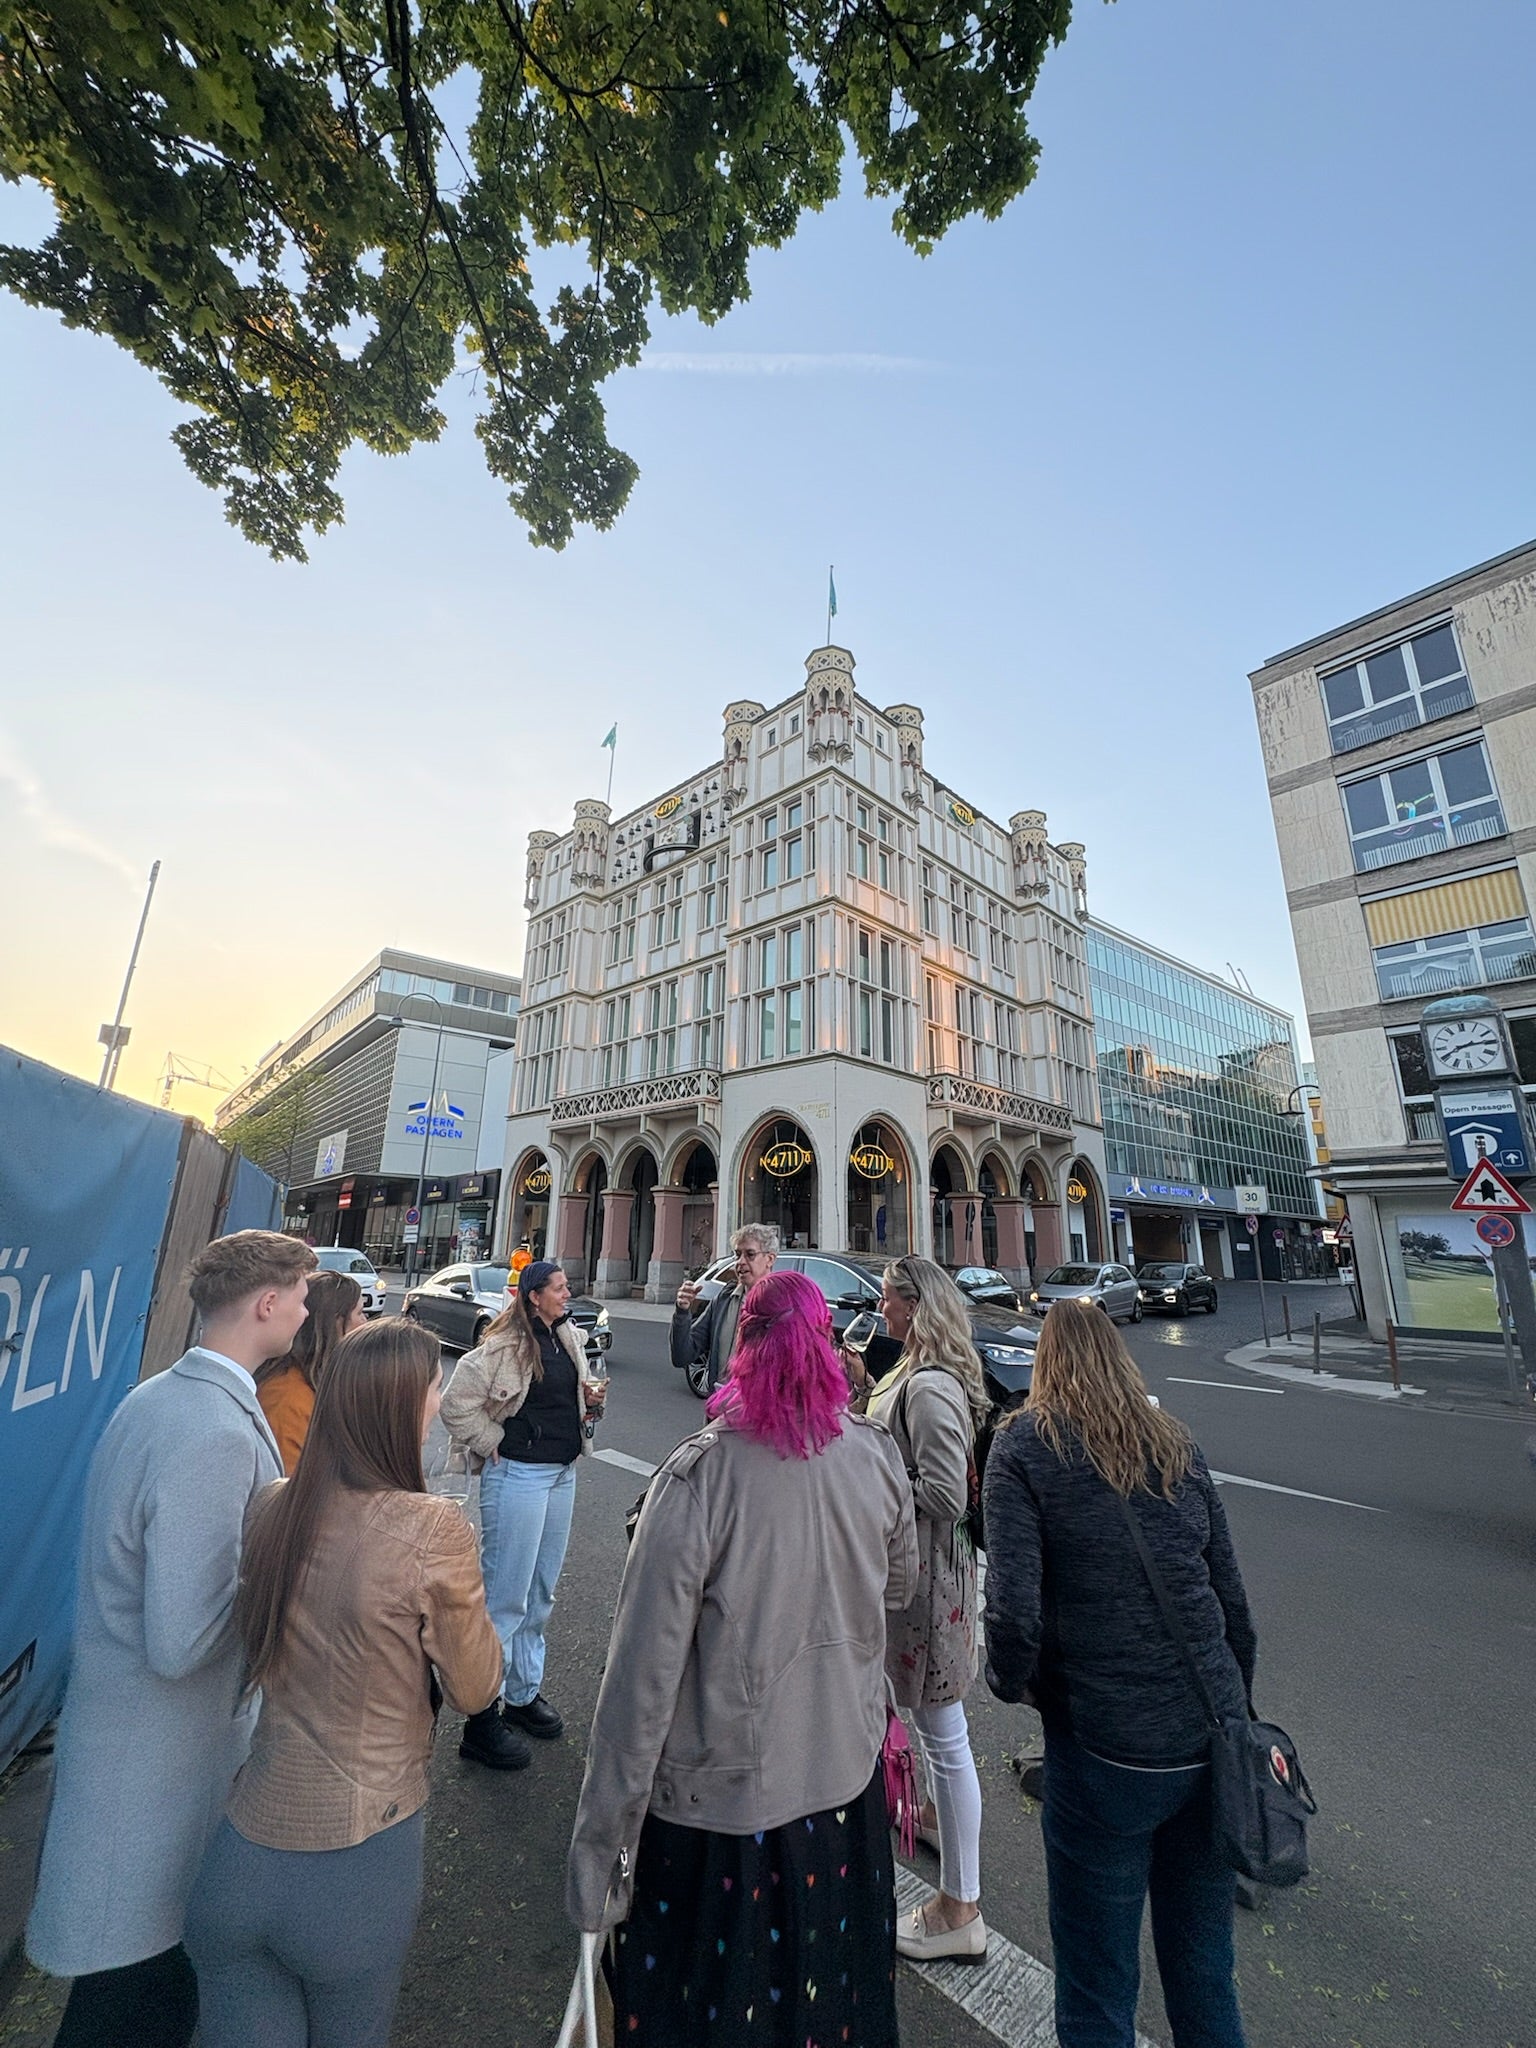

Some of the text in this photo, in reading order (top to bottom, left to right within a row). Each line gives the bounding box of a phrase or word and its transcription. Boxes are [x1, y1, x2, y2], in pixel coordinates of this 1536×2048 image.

[1471, 1103, 1513, 1111] Passagen
[405, 1125, 463, 1139] PASAGEN
[770, 1150, 799, 1168] 4711
[860, 1153, 885, 1170] 4711
[1244, 1192, 1258, 1202] 30
